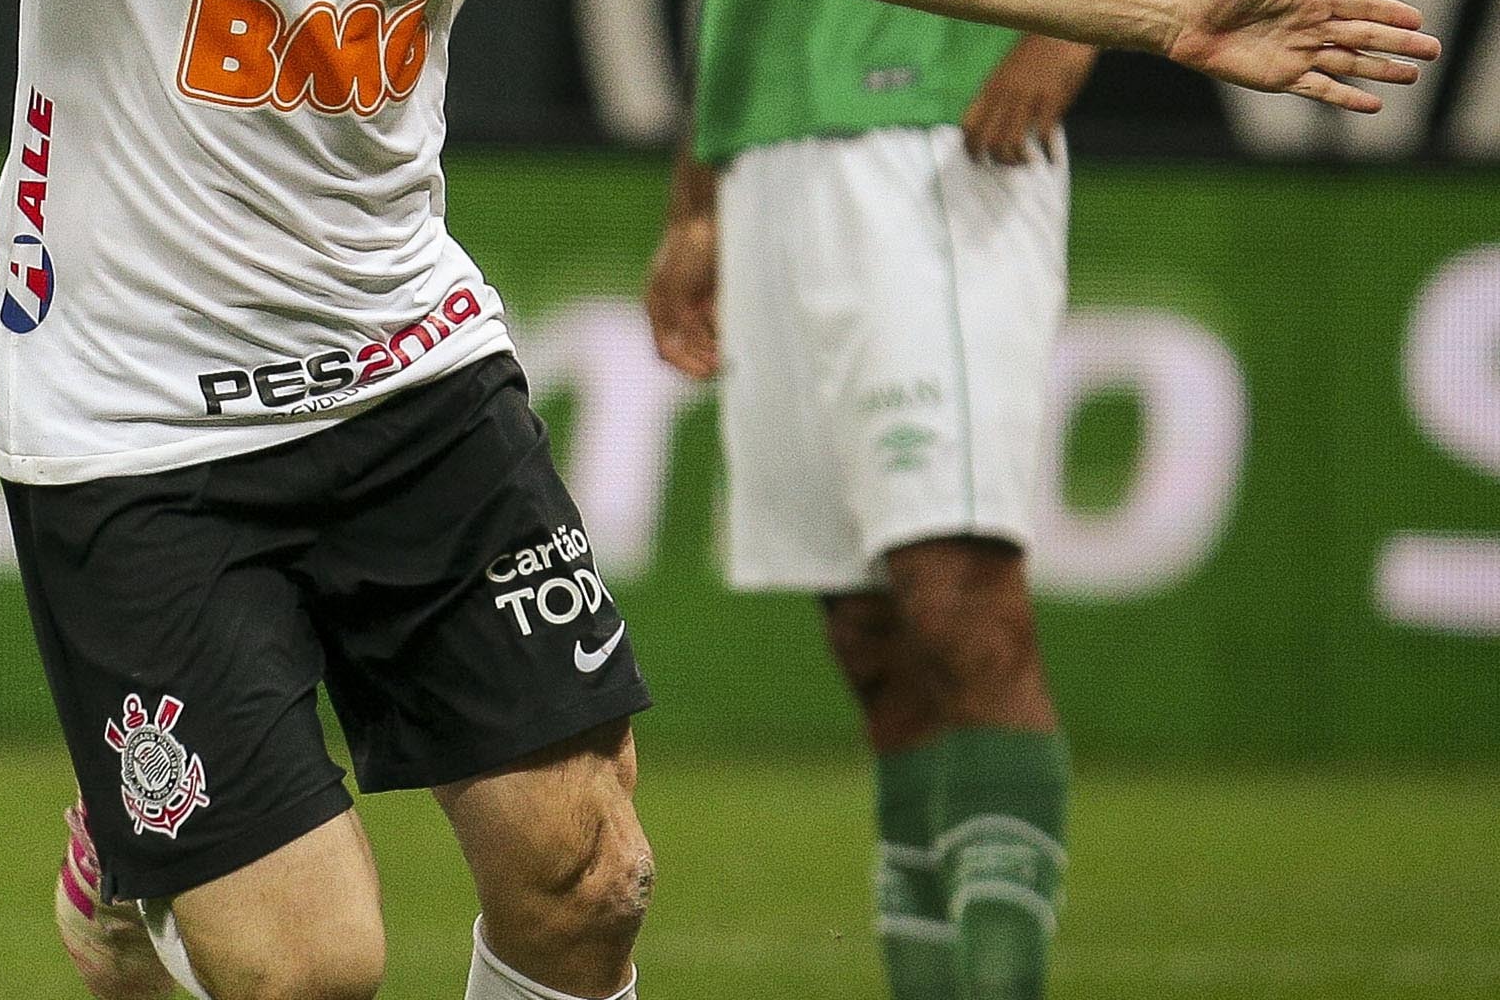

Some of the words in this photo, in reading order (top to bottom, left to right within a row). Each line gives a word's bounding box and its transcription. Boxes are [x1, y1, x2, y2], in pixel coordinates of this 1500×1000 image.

[16, 85, 53, 235] ALE
[485, 524, 589, 583] Cartão
[494, 568, 615, 636] TOD
